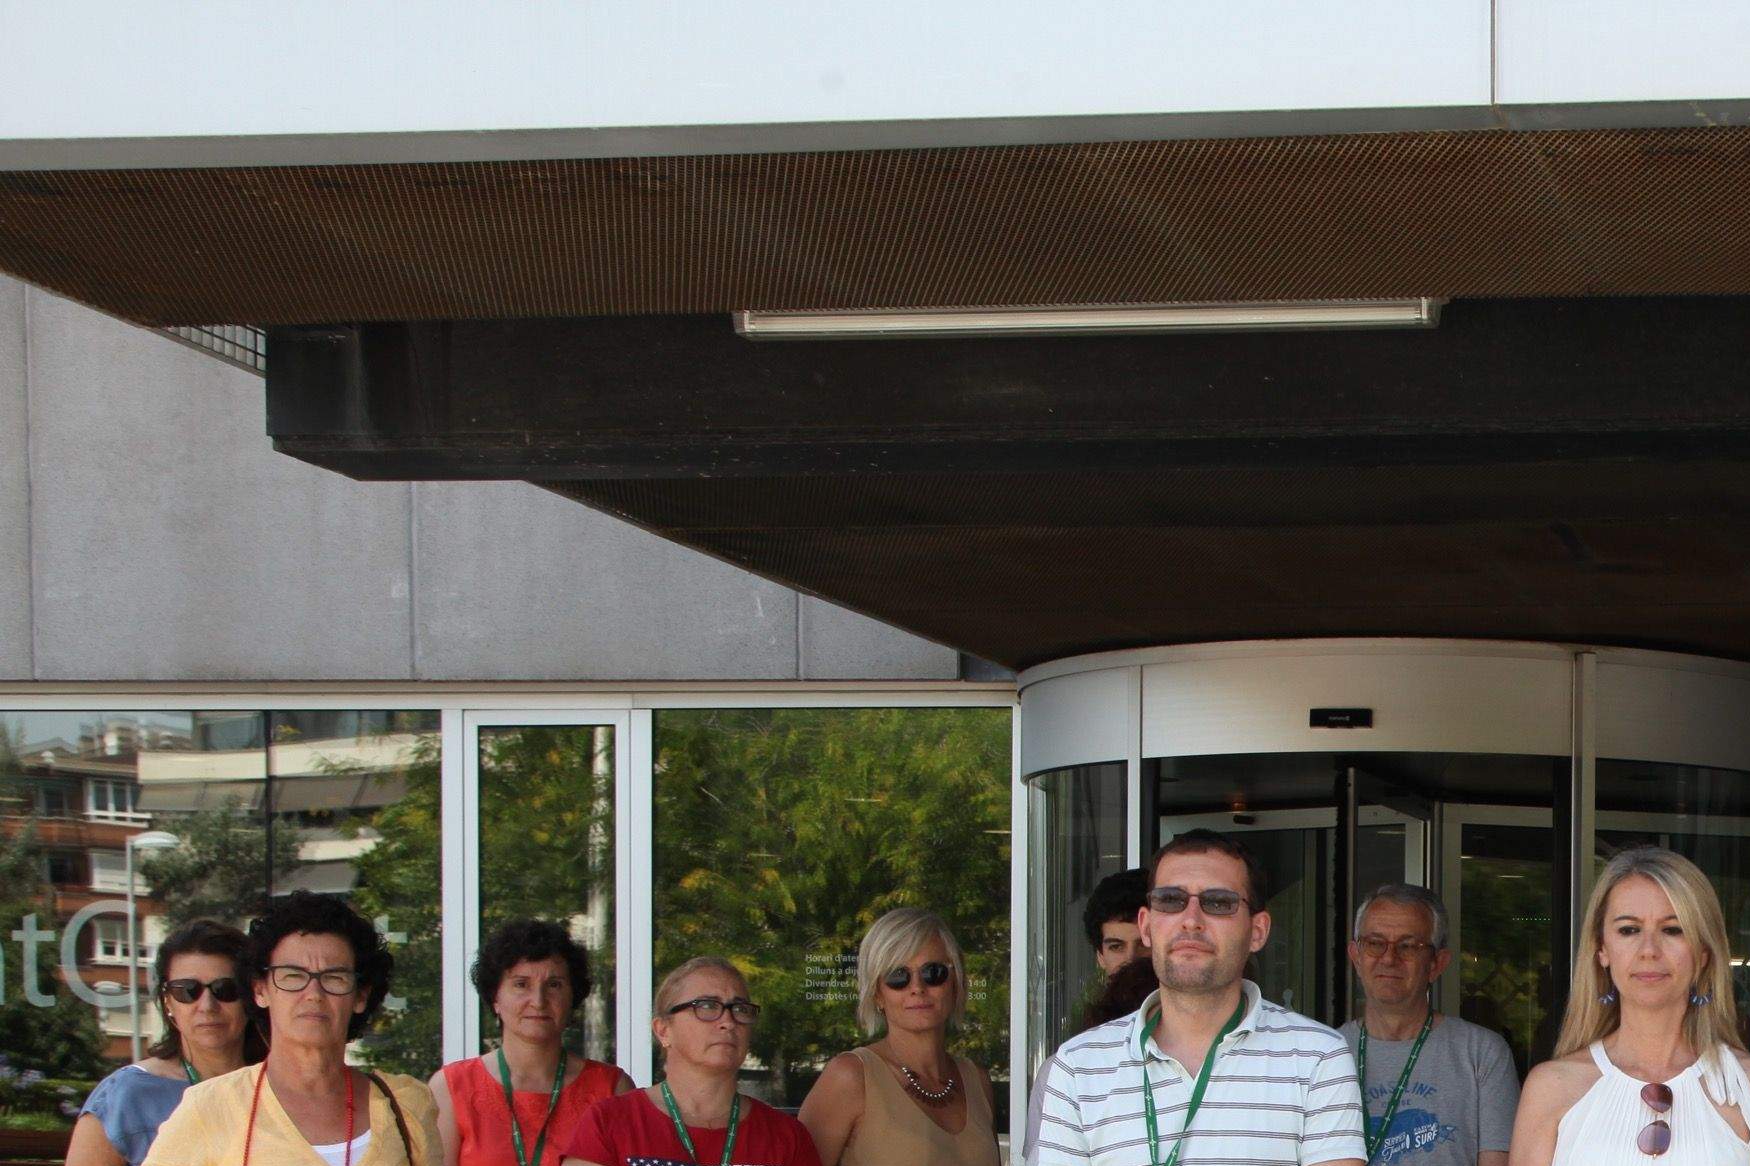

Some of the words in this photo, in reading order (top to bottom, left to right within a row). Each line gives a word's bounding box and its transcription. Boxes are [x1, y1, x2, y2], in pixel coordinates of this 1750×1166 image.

[805, 953, 833, 962] Horari
[805, 966, 836, 975] Dilluns
[844, 966, 857, 976] dij
[805, 979, 849, 987] Divendres
[805, 991, 848, 1000] Dissabtes
[1414, 1129, 1438, 1149] SURF
